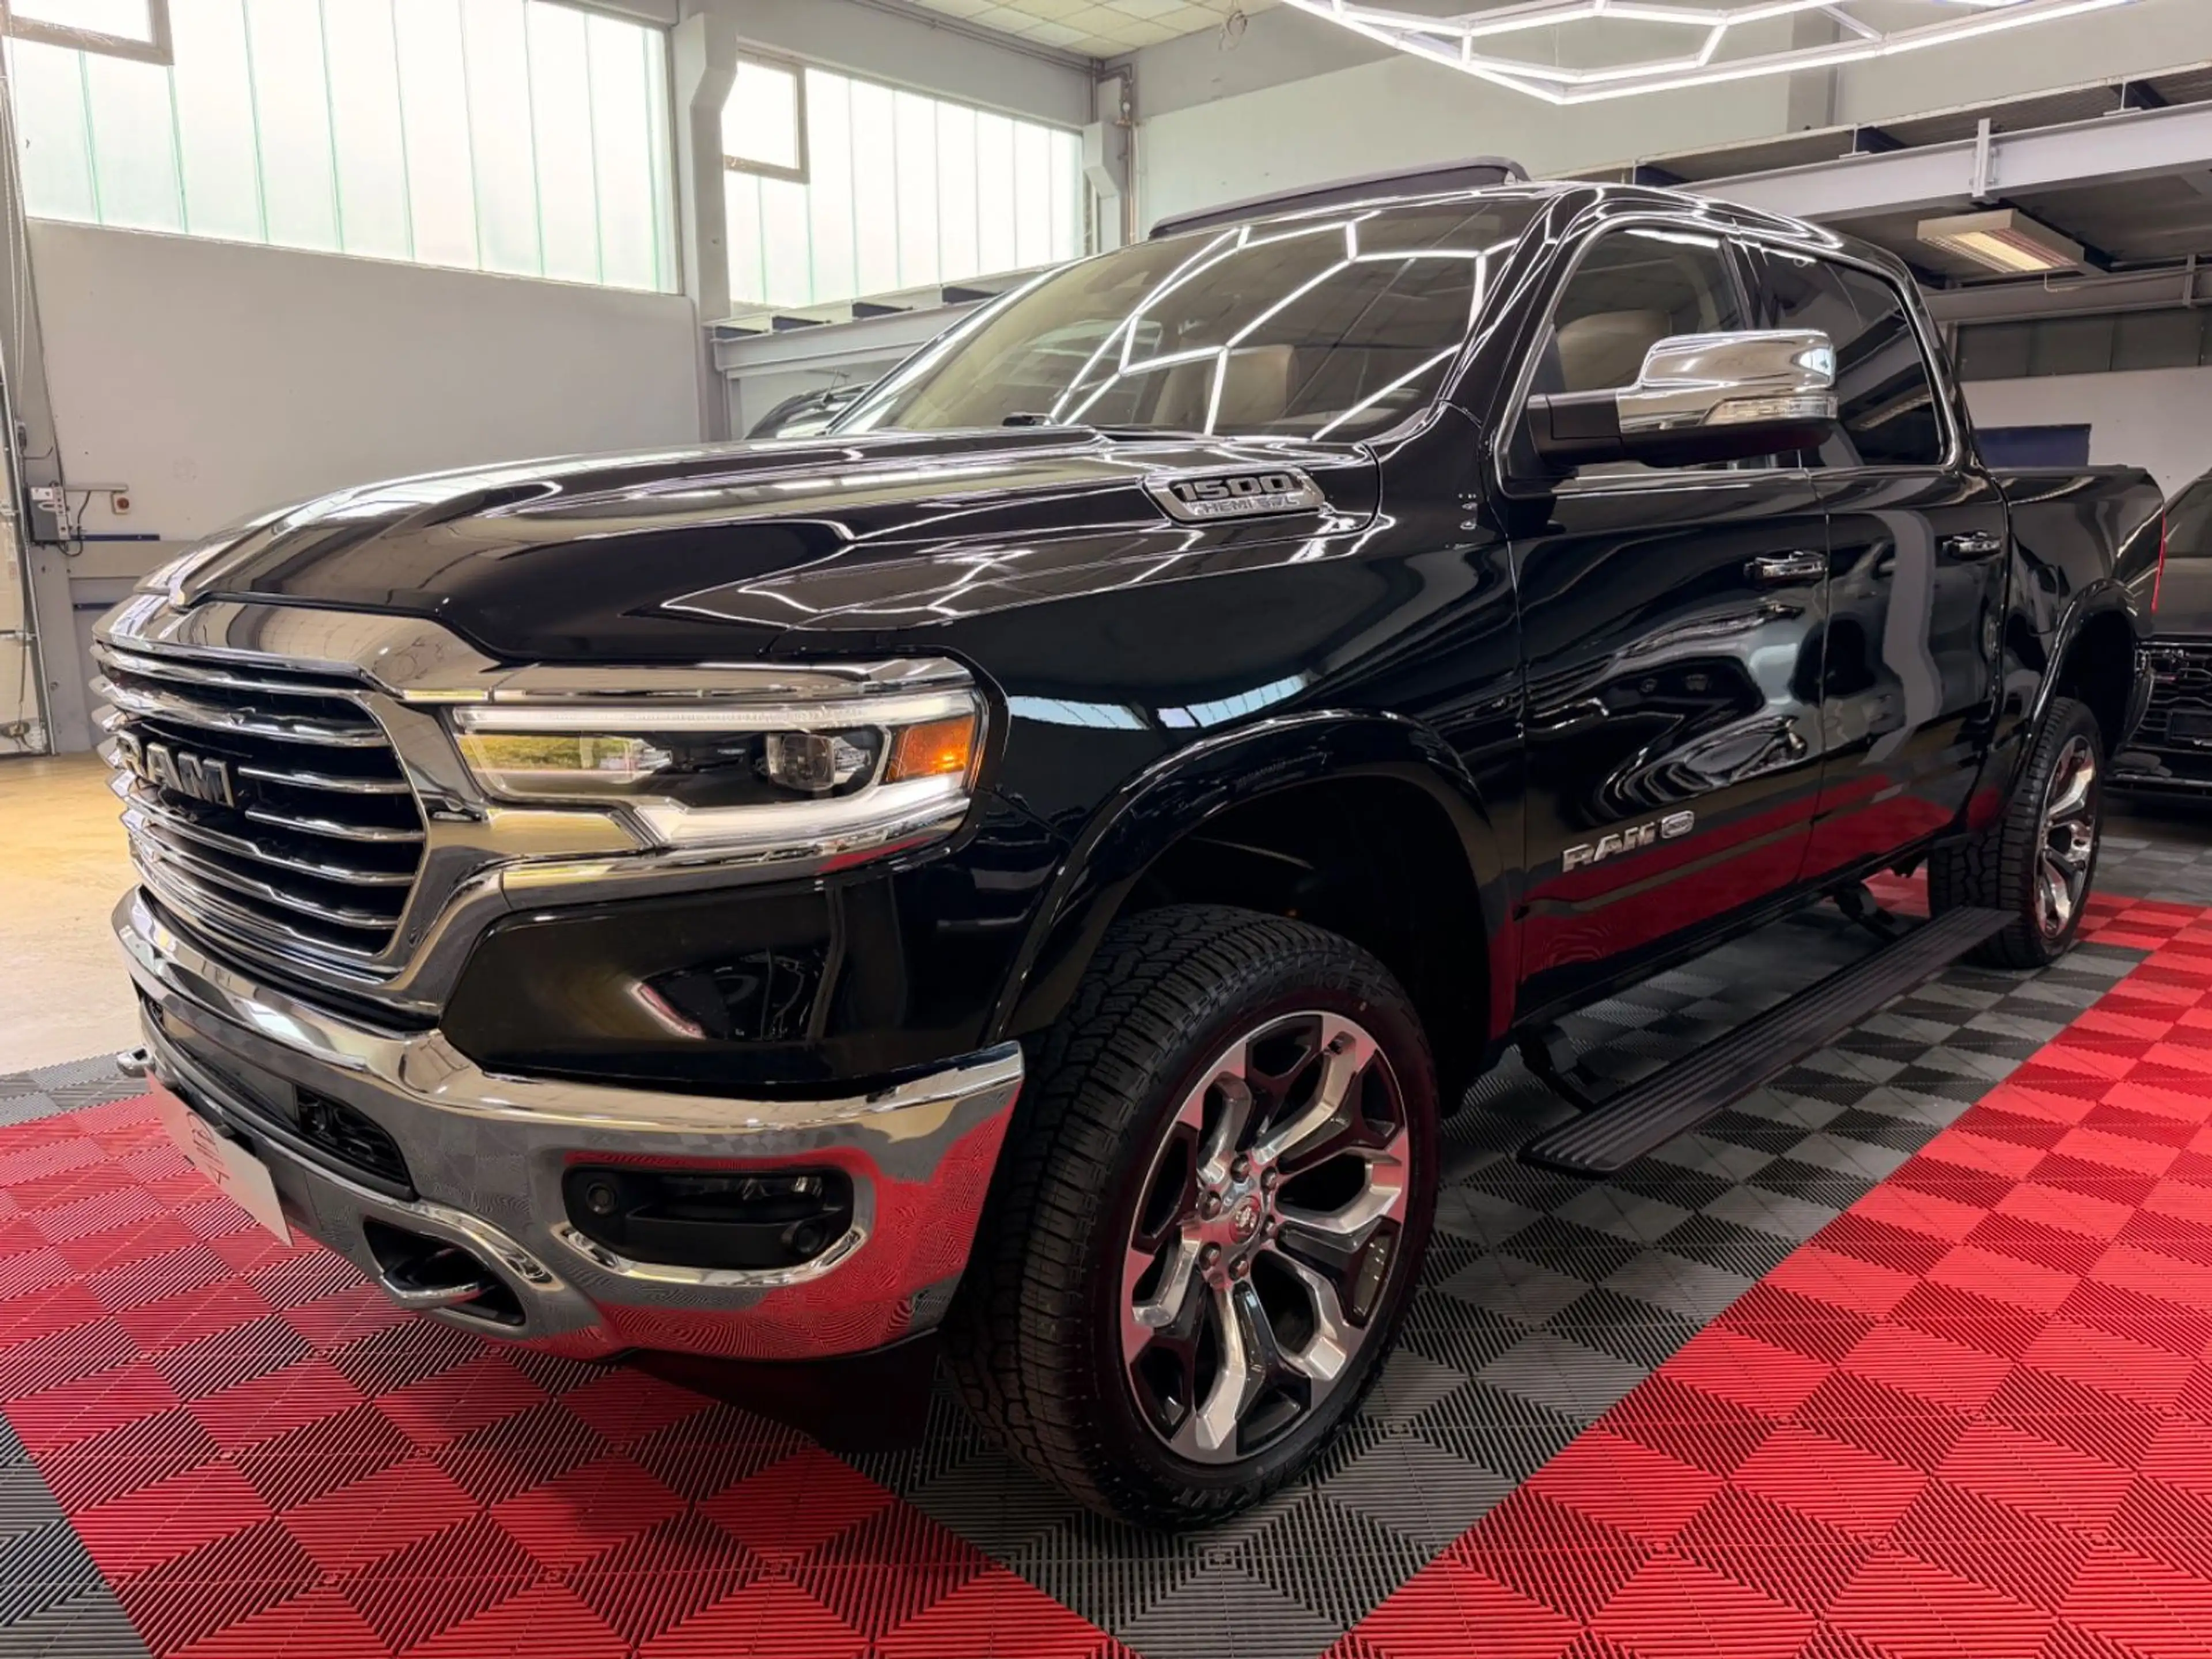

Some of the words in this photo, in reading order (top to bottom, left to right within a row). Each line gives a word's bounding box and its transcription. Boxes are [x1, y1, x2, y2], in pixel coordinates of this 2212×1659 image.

[1174, 473, 1296, 502] 1500
[116, 729, 236, 808] RAM
[1562, 821, 1657, 873] RAM
